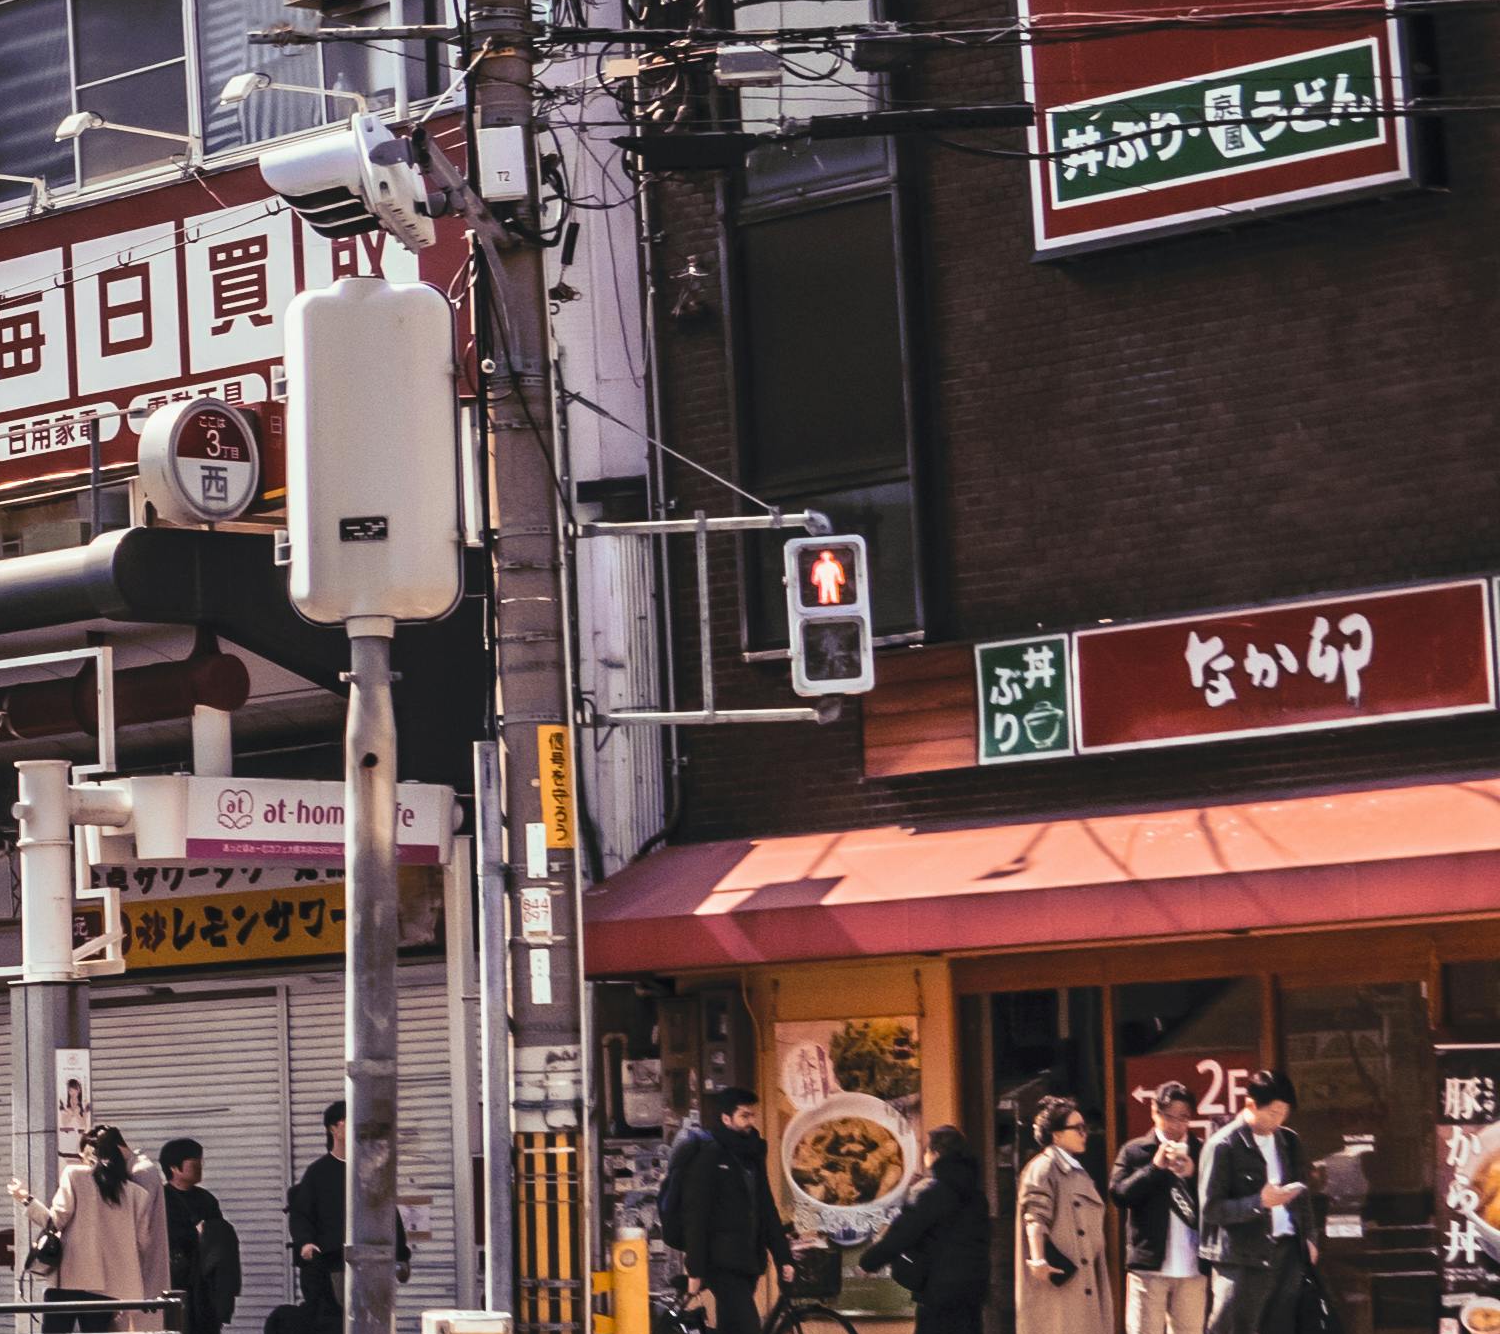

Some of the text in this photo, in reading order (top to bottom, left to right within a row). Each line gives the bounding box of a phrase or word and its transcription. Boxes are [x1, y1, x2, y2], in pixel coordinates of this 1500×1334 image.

[199, 416, 227, 428] ここは
[206, 430, 240, 459] 3丁目
[201, 465, 229, 502] 西
[1184, 612, 1373, 708] なか卯
[226, 796, 244, 815] at
[263, 799, 345, 827] at-hom
[1196, 1059, 1249, 1114] 2F
